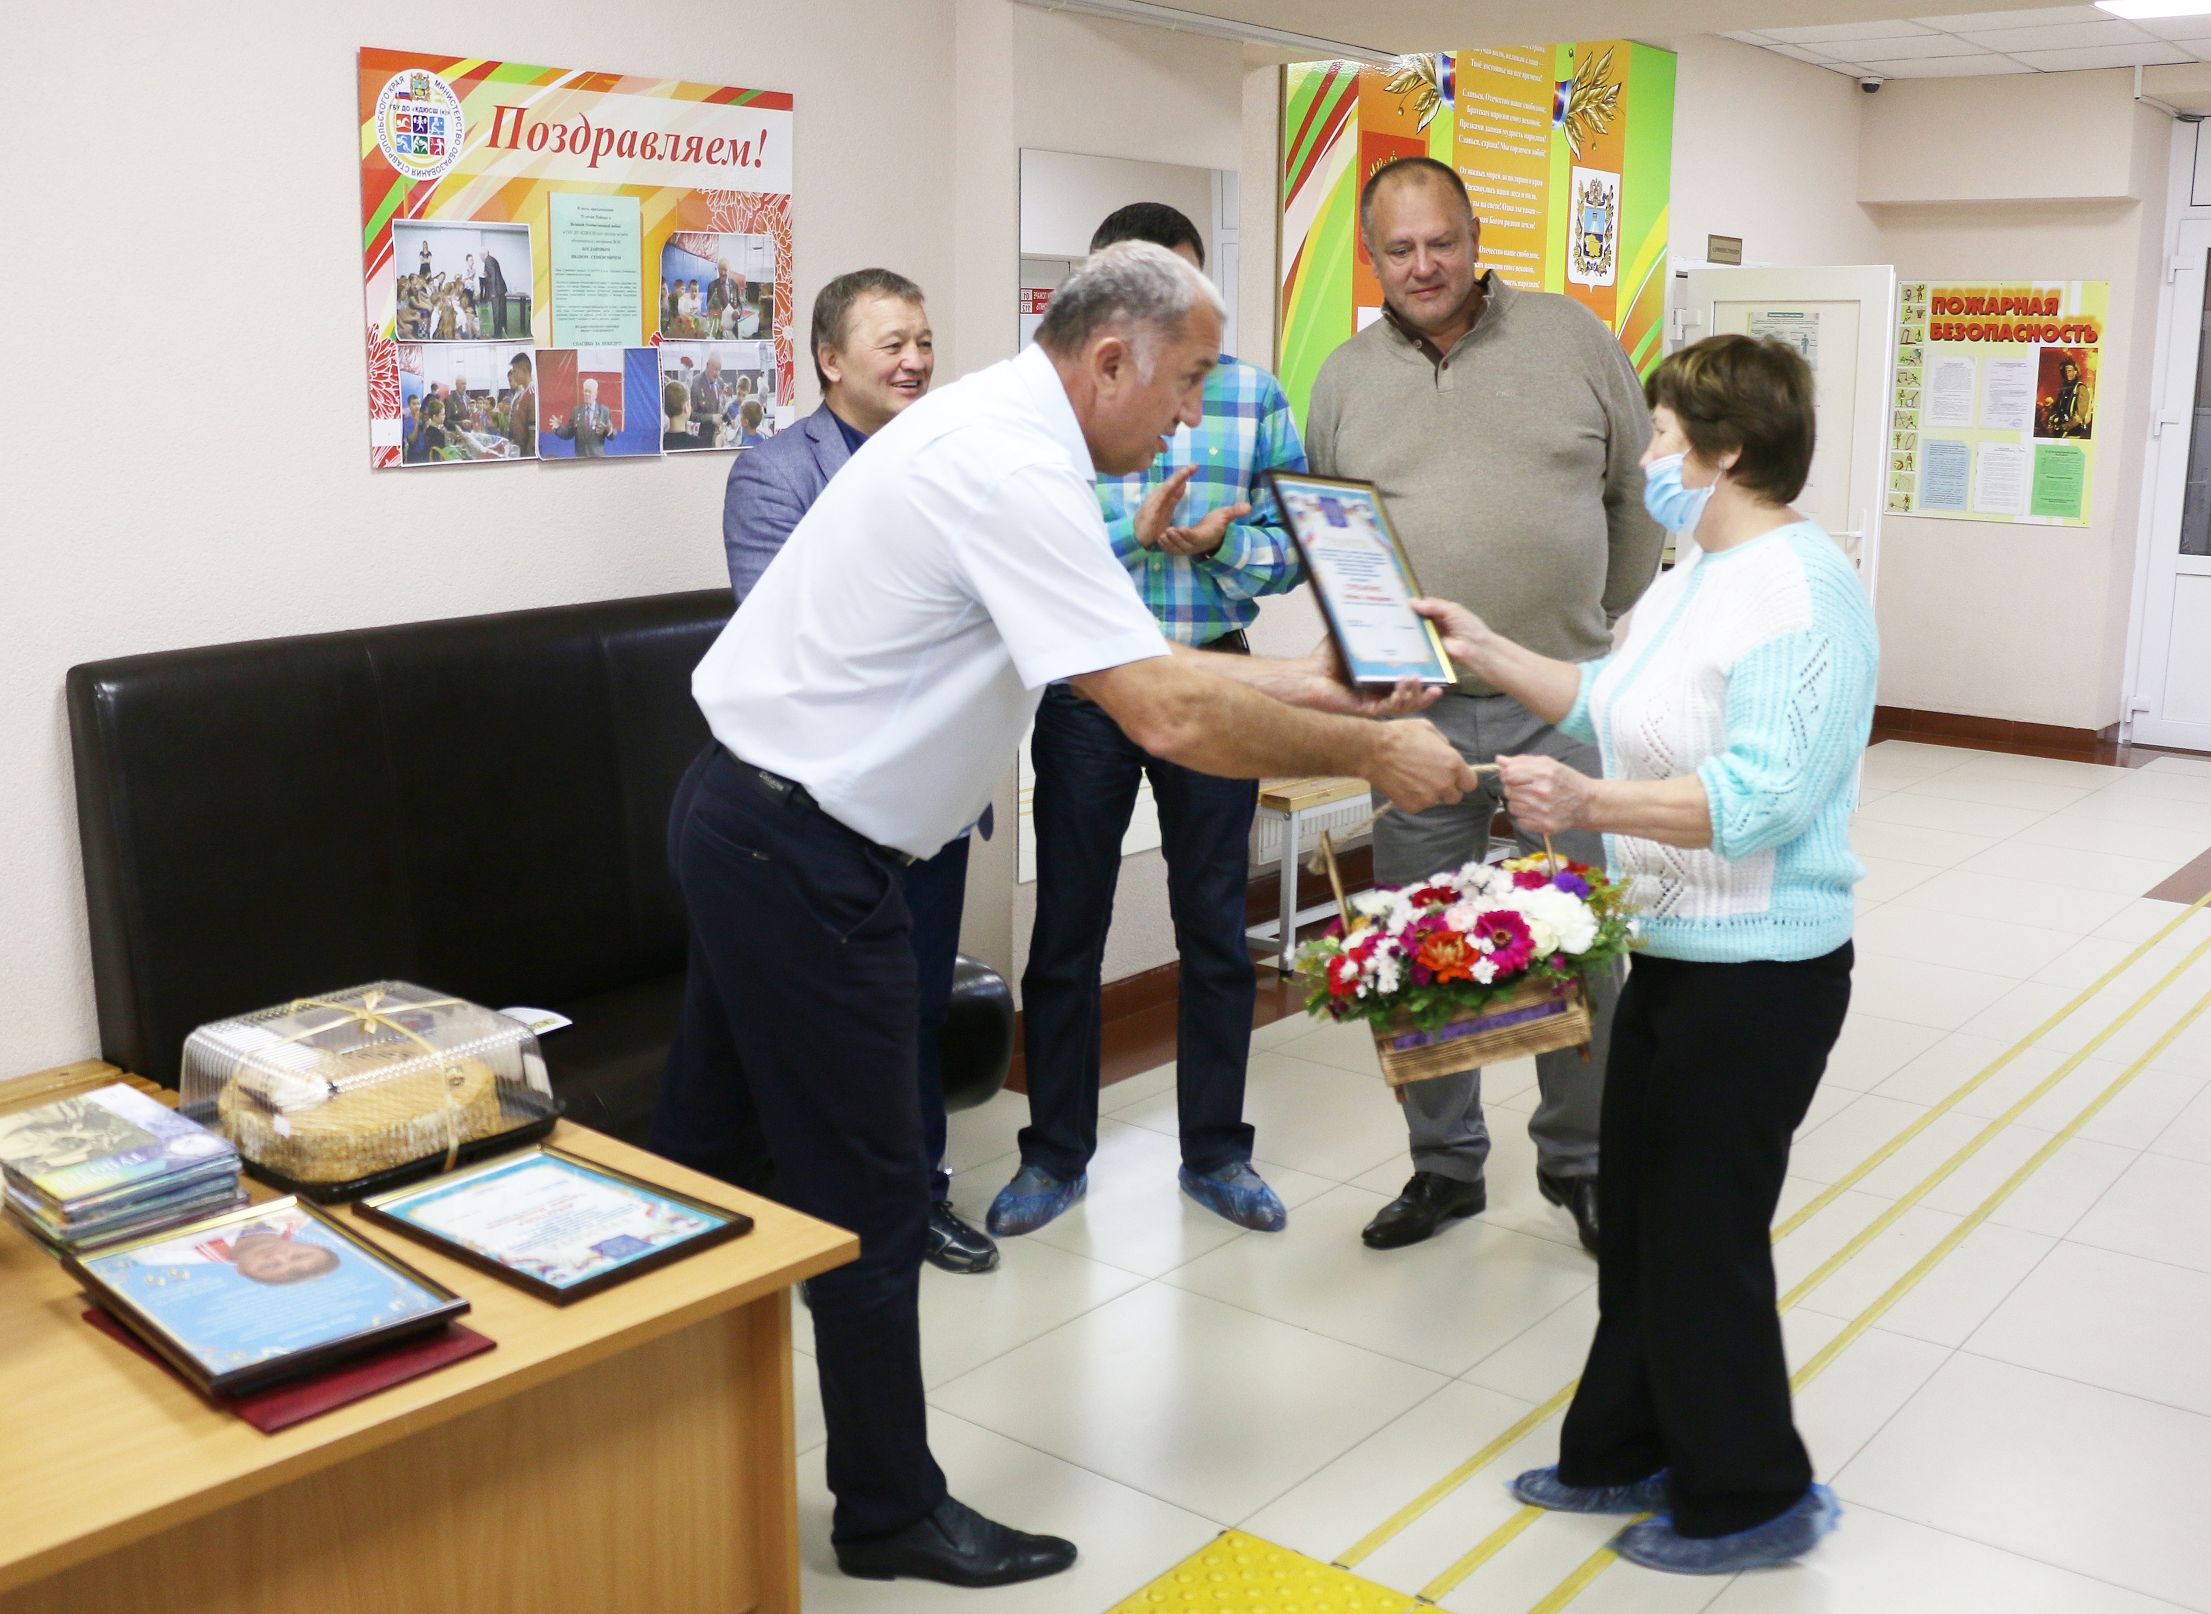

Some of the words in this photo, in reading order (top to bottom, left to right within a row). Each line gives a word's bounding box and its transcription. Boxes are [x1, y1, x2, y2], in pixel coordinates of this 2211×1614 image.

[388, 76, 405, 93] КРАЯ
[434, 80, 462, 146] МИНИСТЕРСТВО
[377, 92, 410, 176] СТАВРОПОЛЬСКОГО
[485, 105, 767, 168] Поздравляем!
[411, 147, 459, 178] ОБРАЗОВАНИЯ
[1931, 296, 2059, 316] ПОЖАРНАЯ
[1929, 322, 2099, 343] БЕЗОПАСНОСТЬ
